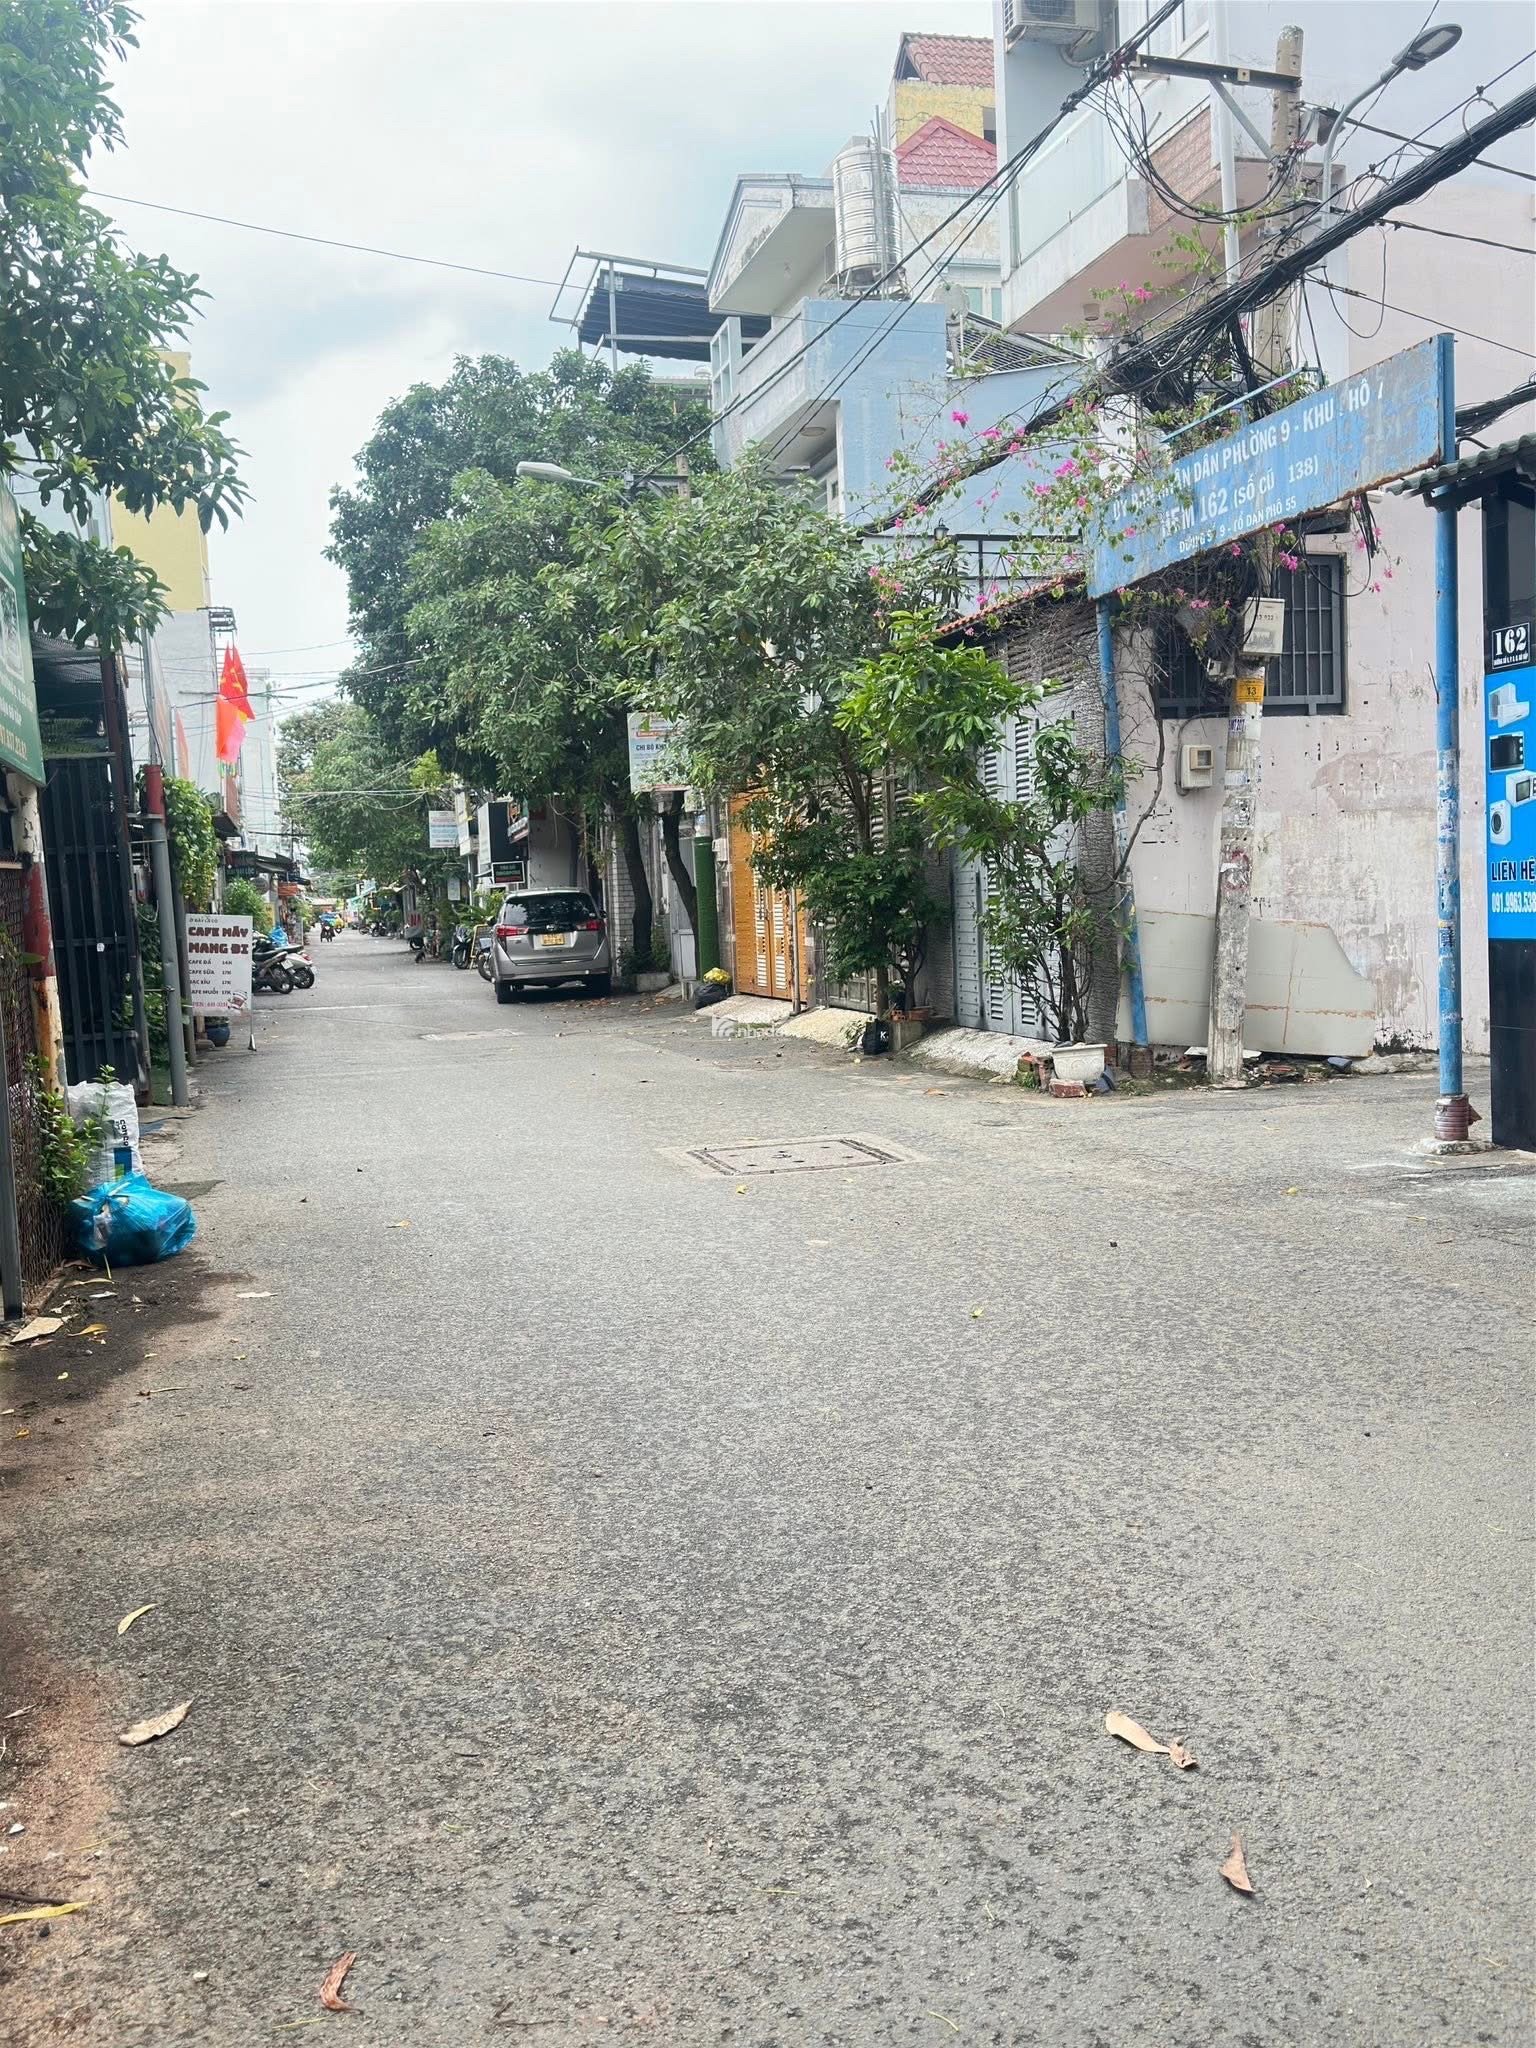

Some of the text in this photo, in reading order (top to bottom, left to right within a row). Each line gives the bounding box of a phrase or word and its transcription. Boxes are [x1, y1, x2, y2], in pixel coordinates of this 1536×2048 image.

[1194, 453, 1219, 483] DÂN
[1280, 419, 1290, 442] 9
[1303, 398, 1334, 432] KHU
[1200, 487, 1229, 523] 162
[1234, 472, 1255, 509] (SỐ
[1288, 455, 1319, 484] 138)
[1219, 524, 1225, 537] 9
[1285, 495, 1297, 511] 55
[1495, 626, 1527, 656] 162
[1491, 856, 1536, 886] LIÊN HỆ
[188, 927, 220, 937] CAFE
[188, 942, 249, 955] MANG ĐI
